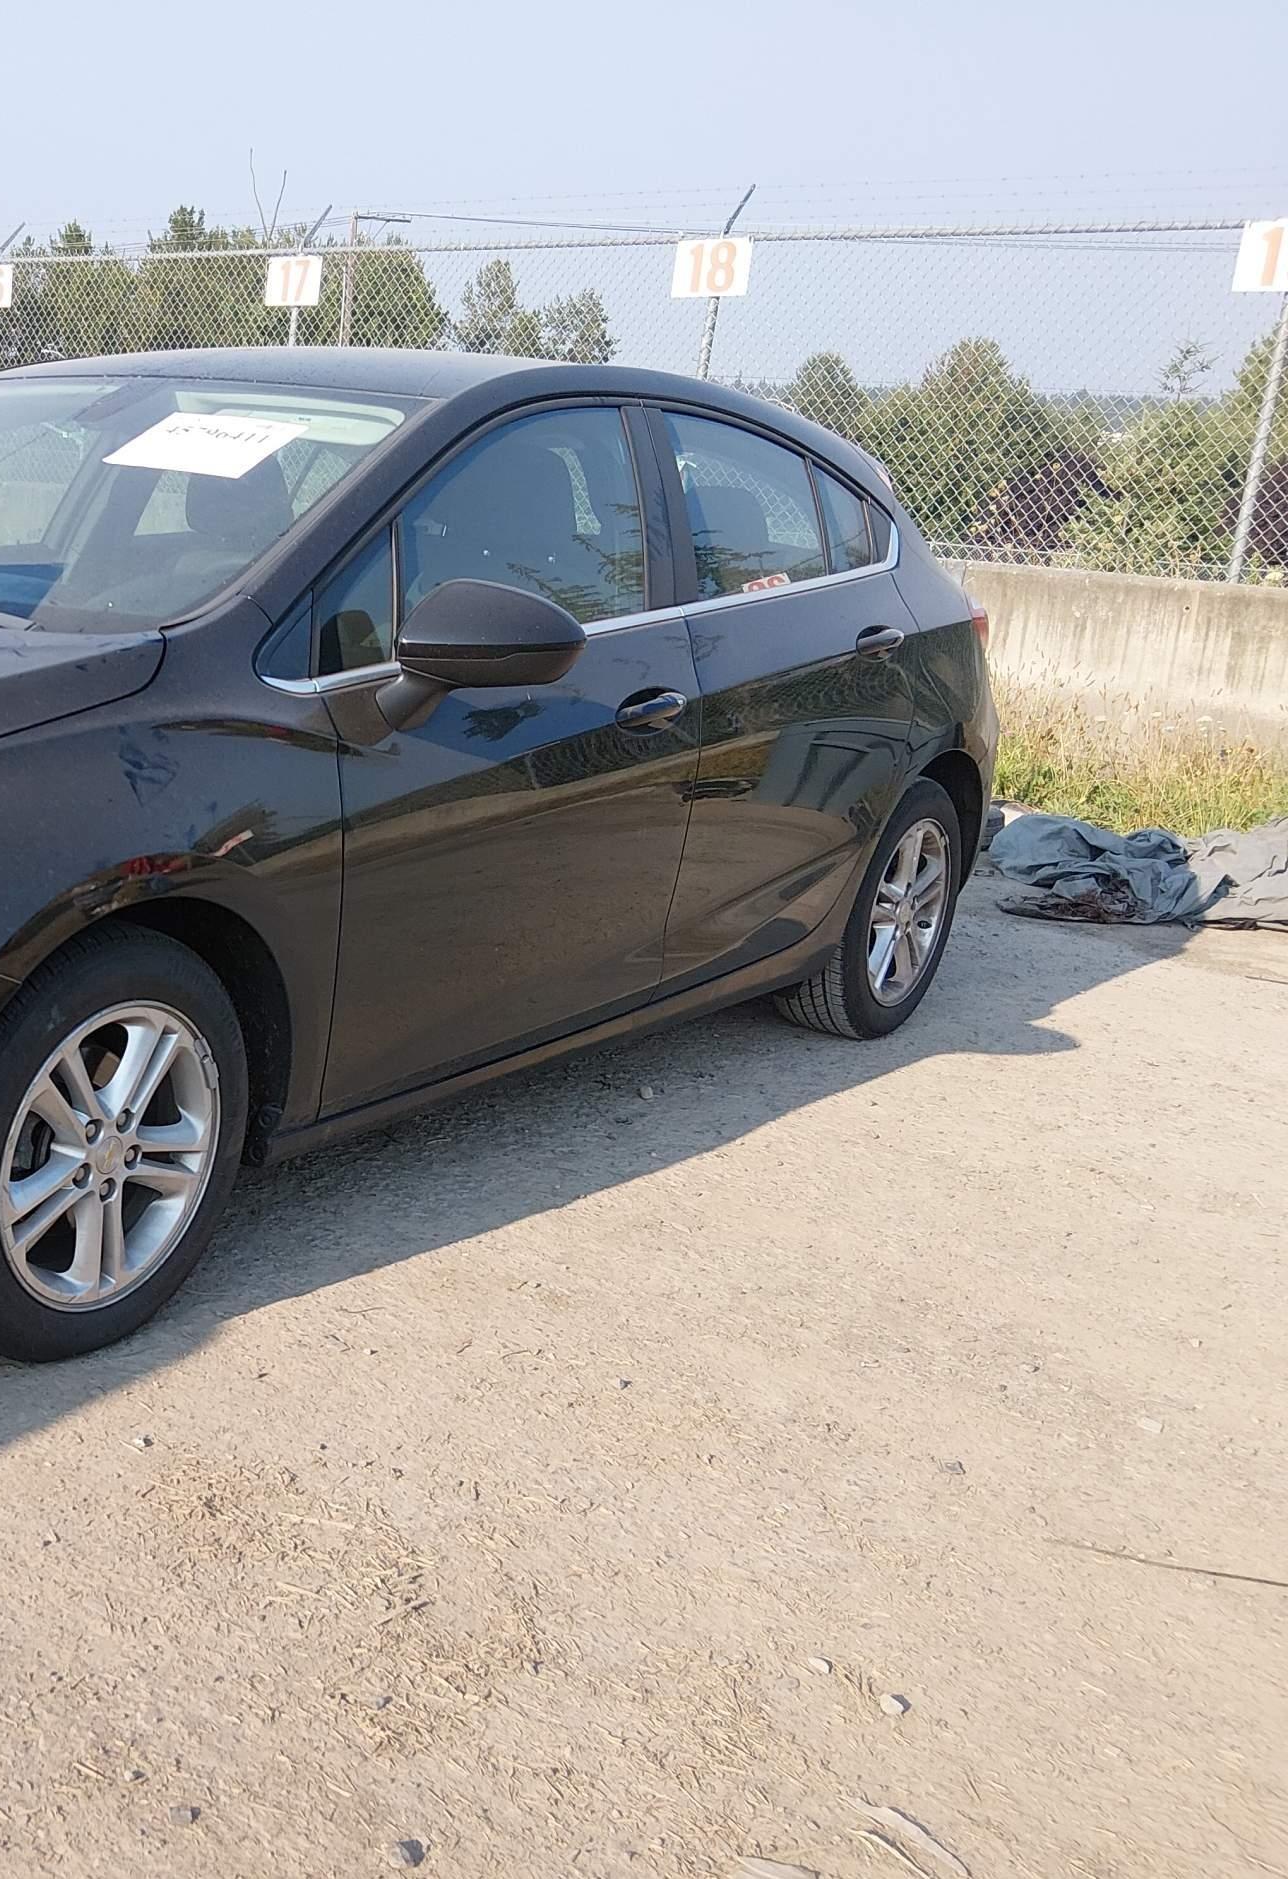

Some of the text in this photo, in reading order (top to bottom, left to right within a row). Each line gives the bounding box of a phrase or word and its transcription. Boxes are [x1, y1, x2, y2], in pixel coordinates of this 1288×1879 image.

[281, 259, 311, 302] 17
[689, 241, 736, 293] 18
[1260, 226, 1288, 287] 1
